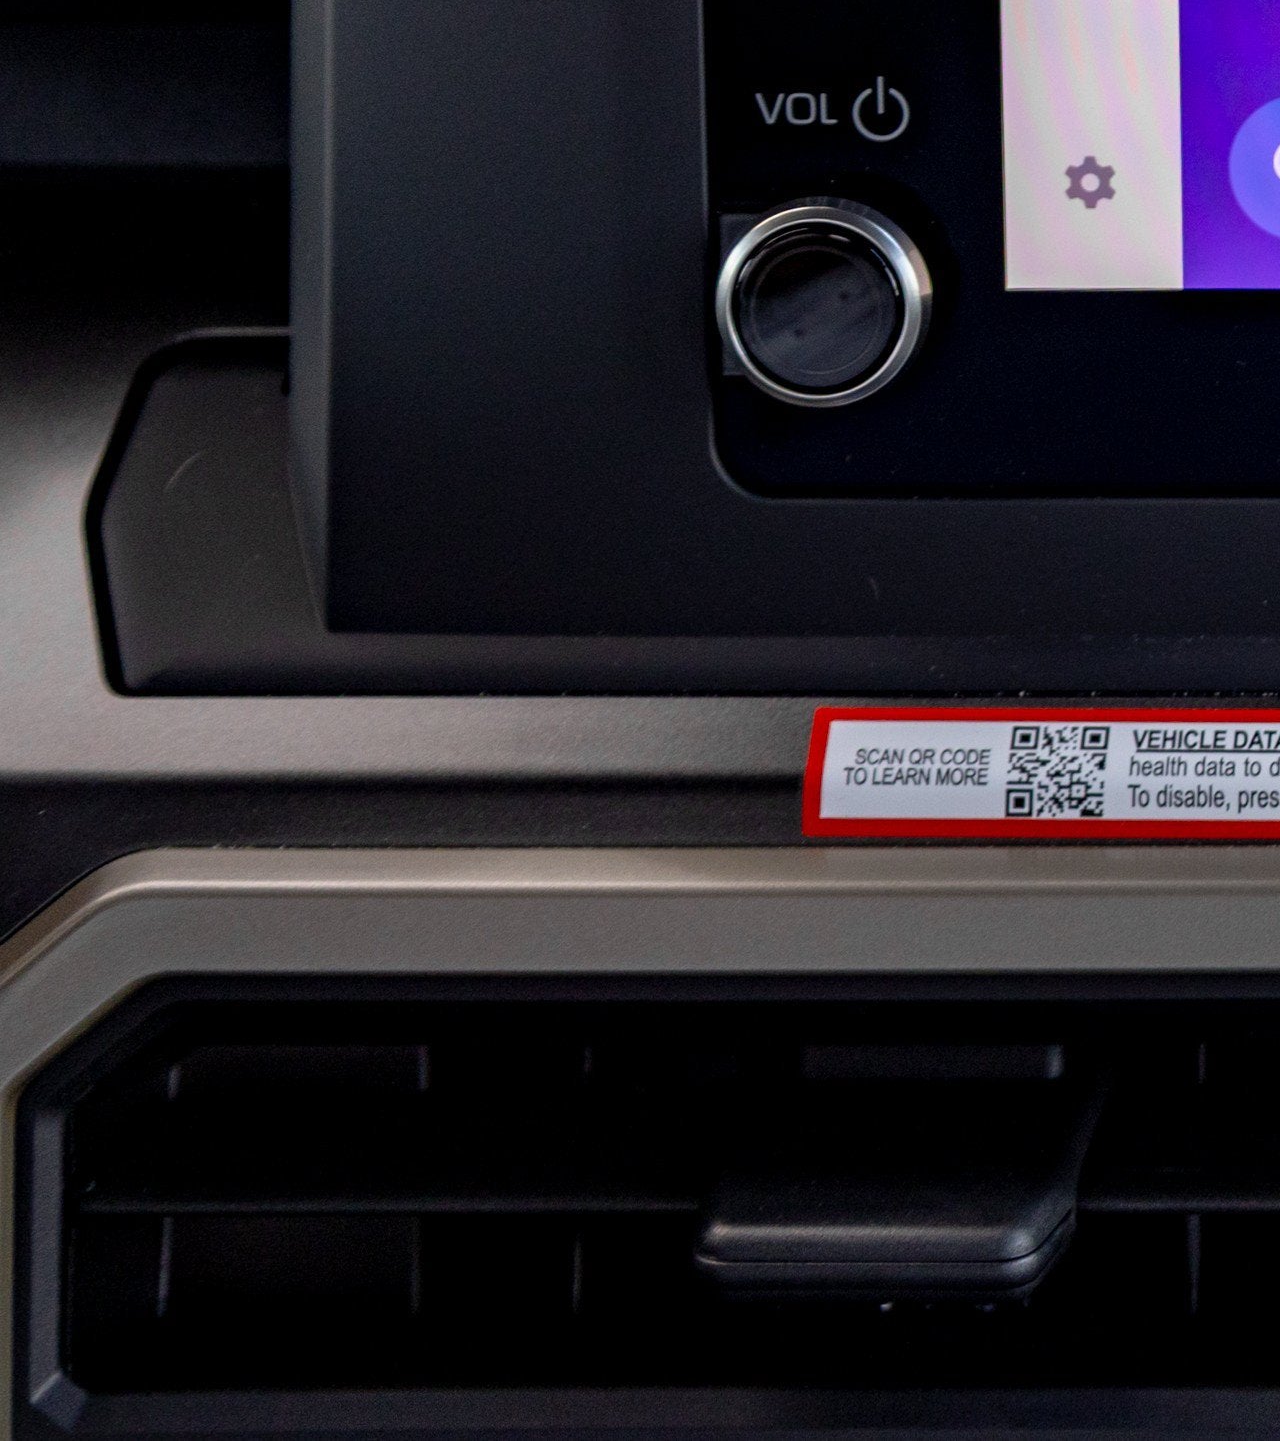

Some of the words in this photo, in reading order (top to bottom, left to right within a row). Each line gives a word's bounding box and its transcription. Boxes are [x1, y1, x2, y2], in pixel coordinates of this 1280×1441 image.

[755, 92, 838, 125] VOL
[1133, 730, 1226, 750] VEHICLE
[855, 749, 903, 765] SCAN
[908, 749, 936, 766] QR
[940, 749, 991, 765] CODE
[1129, 757, 1188, 778] health
[1194, 757, 1238, 778] data
[1244, 758, 1263, 778] to
[844, 767, 868, 785] TO
[871, 767, 931, 786] LEARN
[934, 767, 988, 786] MORE
[1129, 786, 1152, 808] To
[1156, 786, 1231, 812] disable,
